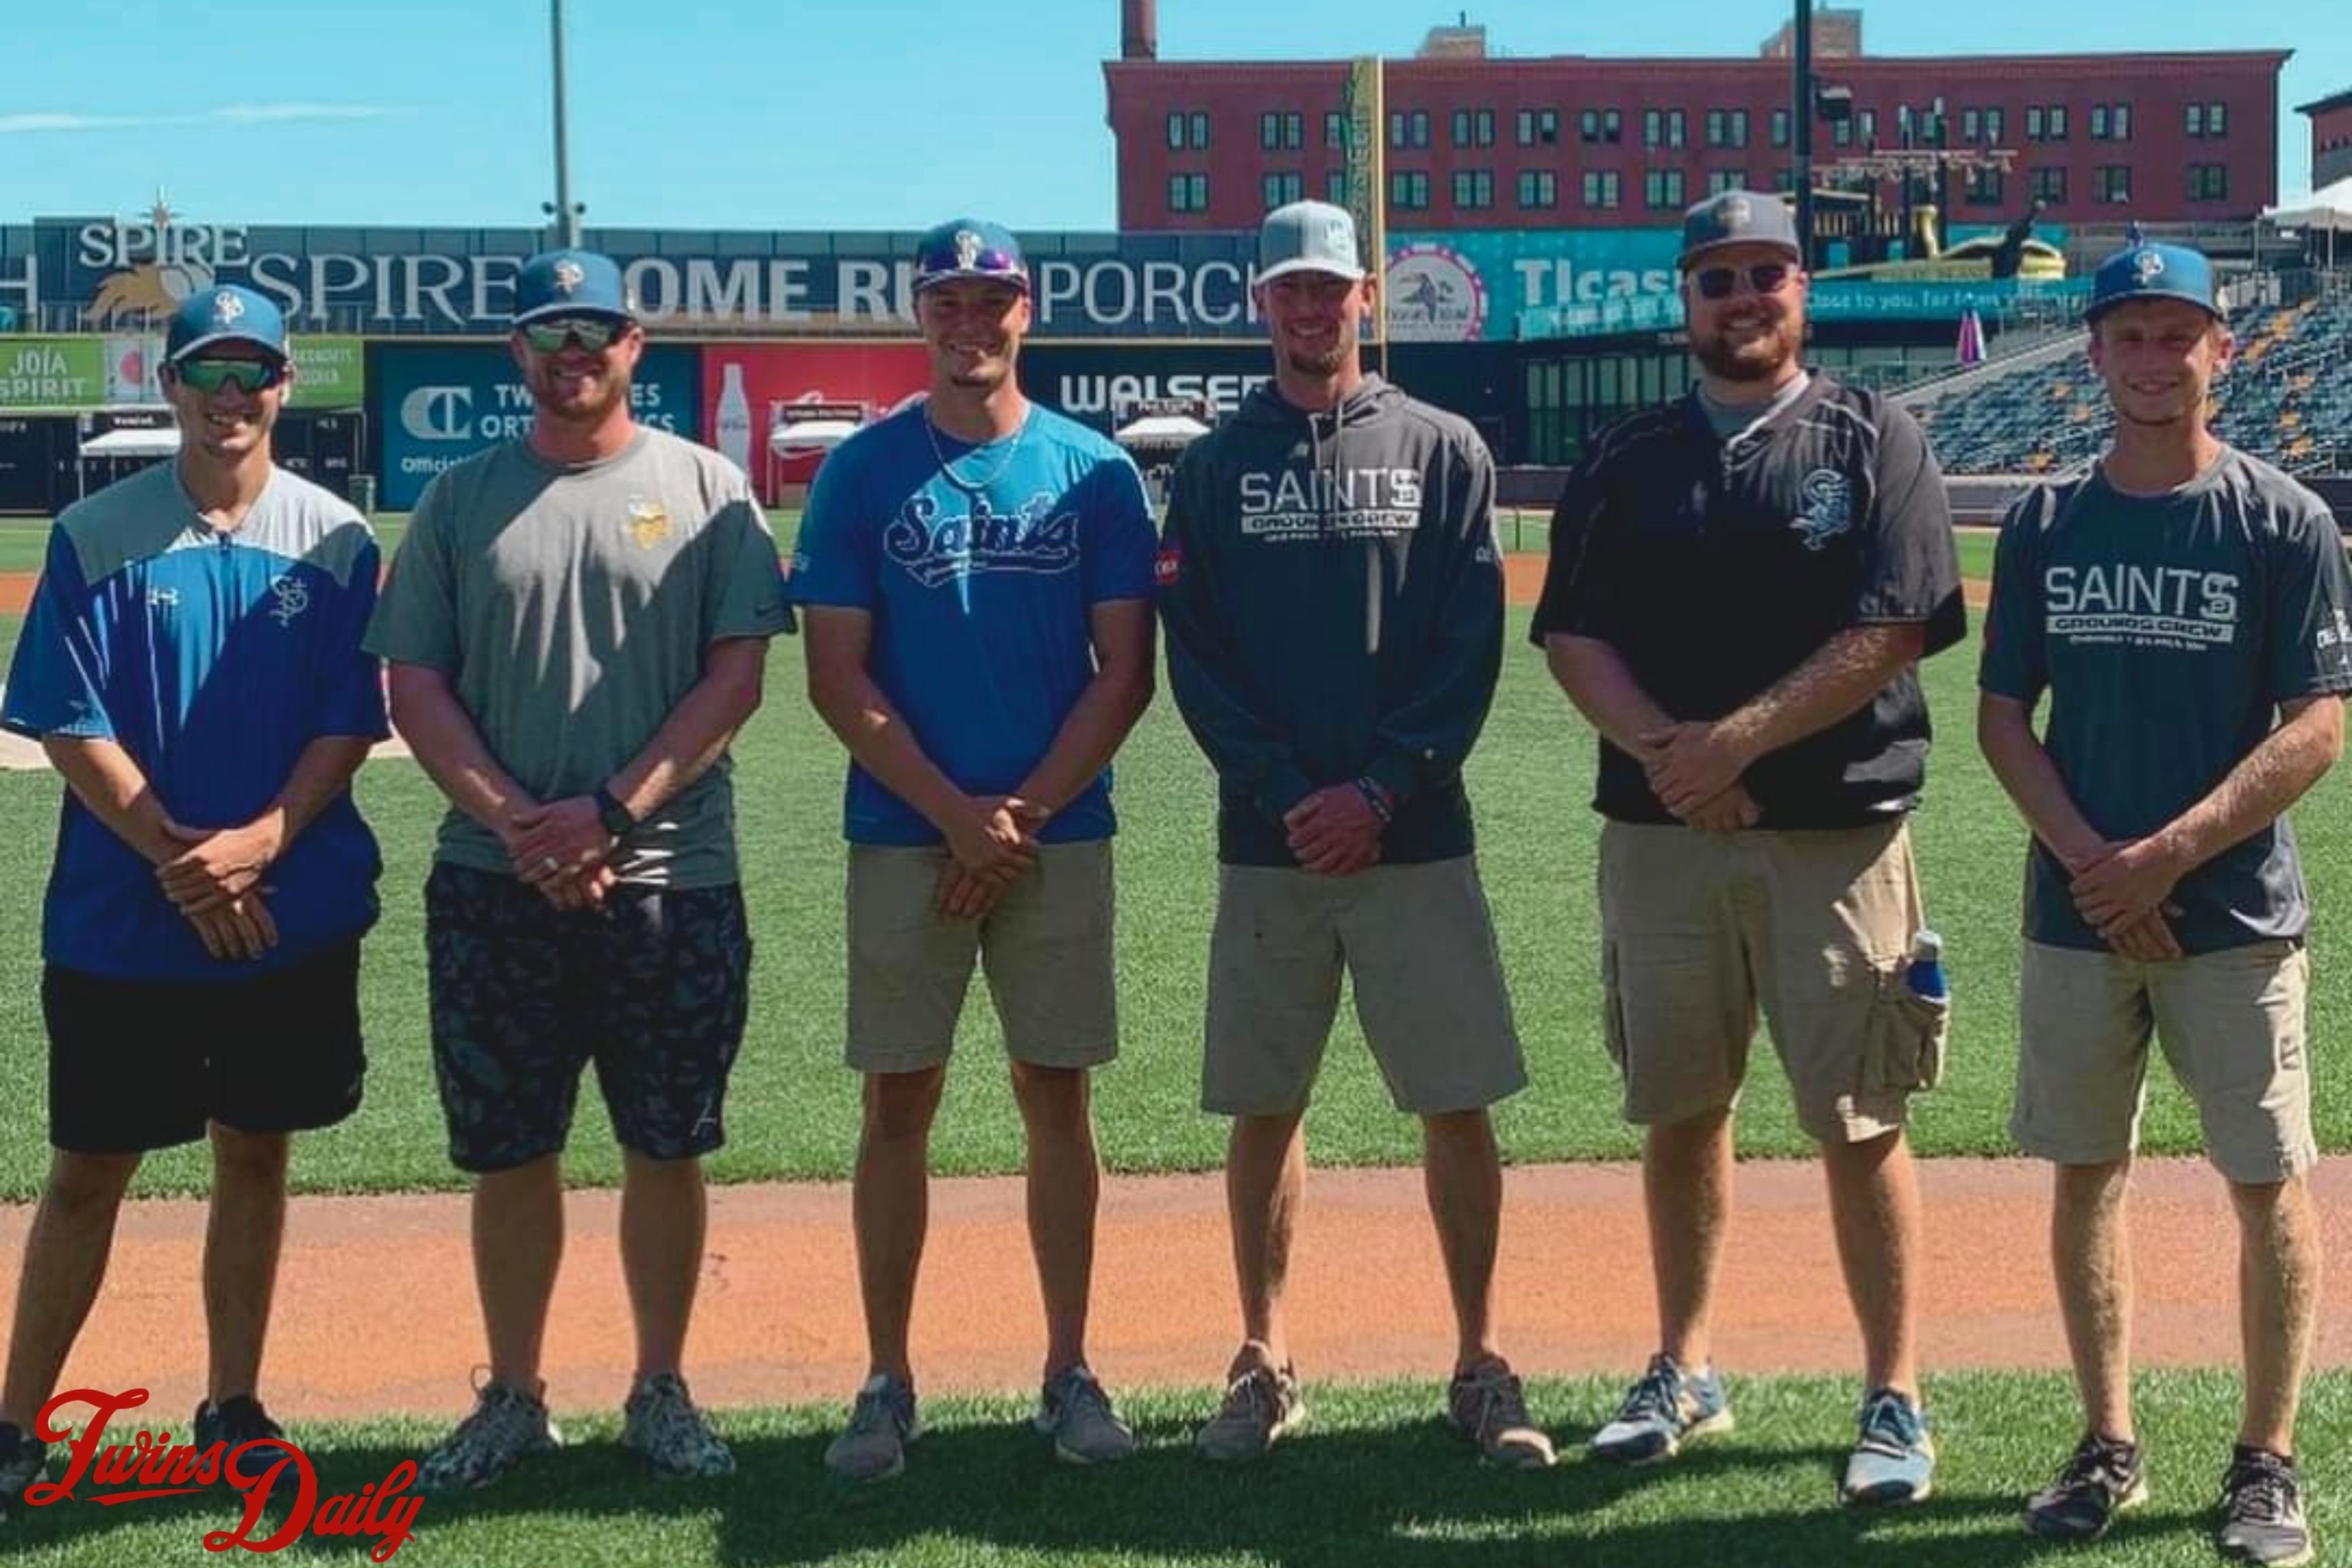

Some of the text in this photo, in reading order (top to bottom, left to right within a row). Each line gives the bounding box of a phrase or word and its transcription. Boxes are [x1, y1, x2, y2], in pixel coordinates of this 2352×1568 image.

[79, 223, 250, 273] SPIRE
[250, 253, 523, 325] SPIRE
[1241, 468, 1421, 513] SAINTS
[884, 491, 1079, 578] Saints
[2045, 564, 2239, 621] SAINTS
